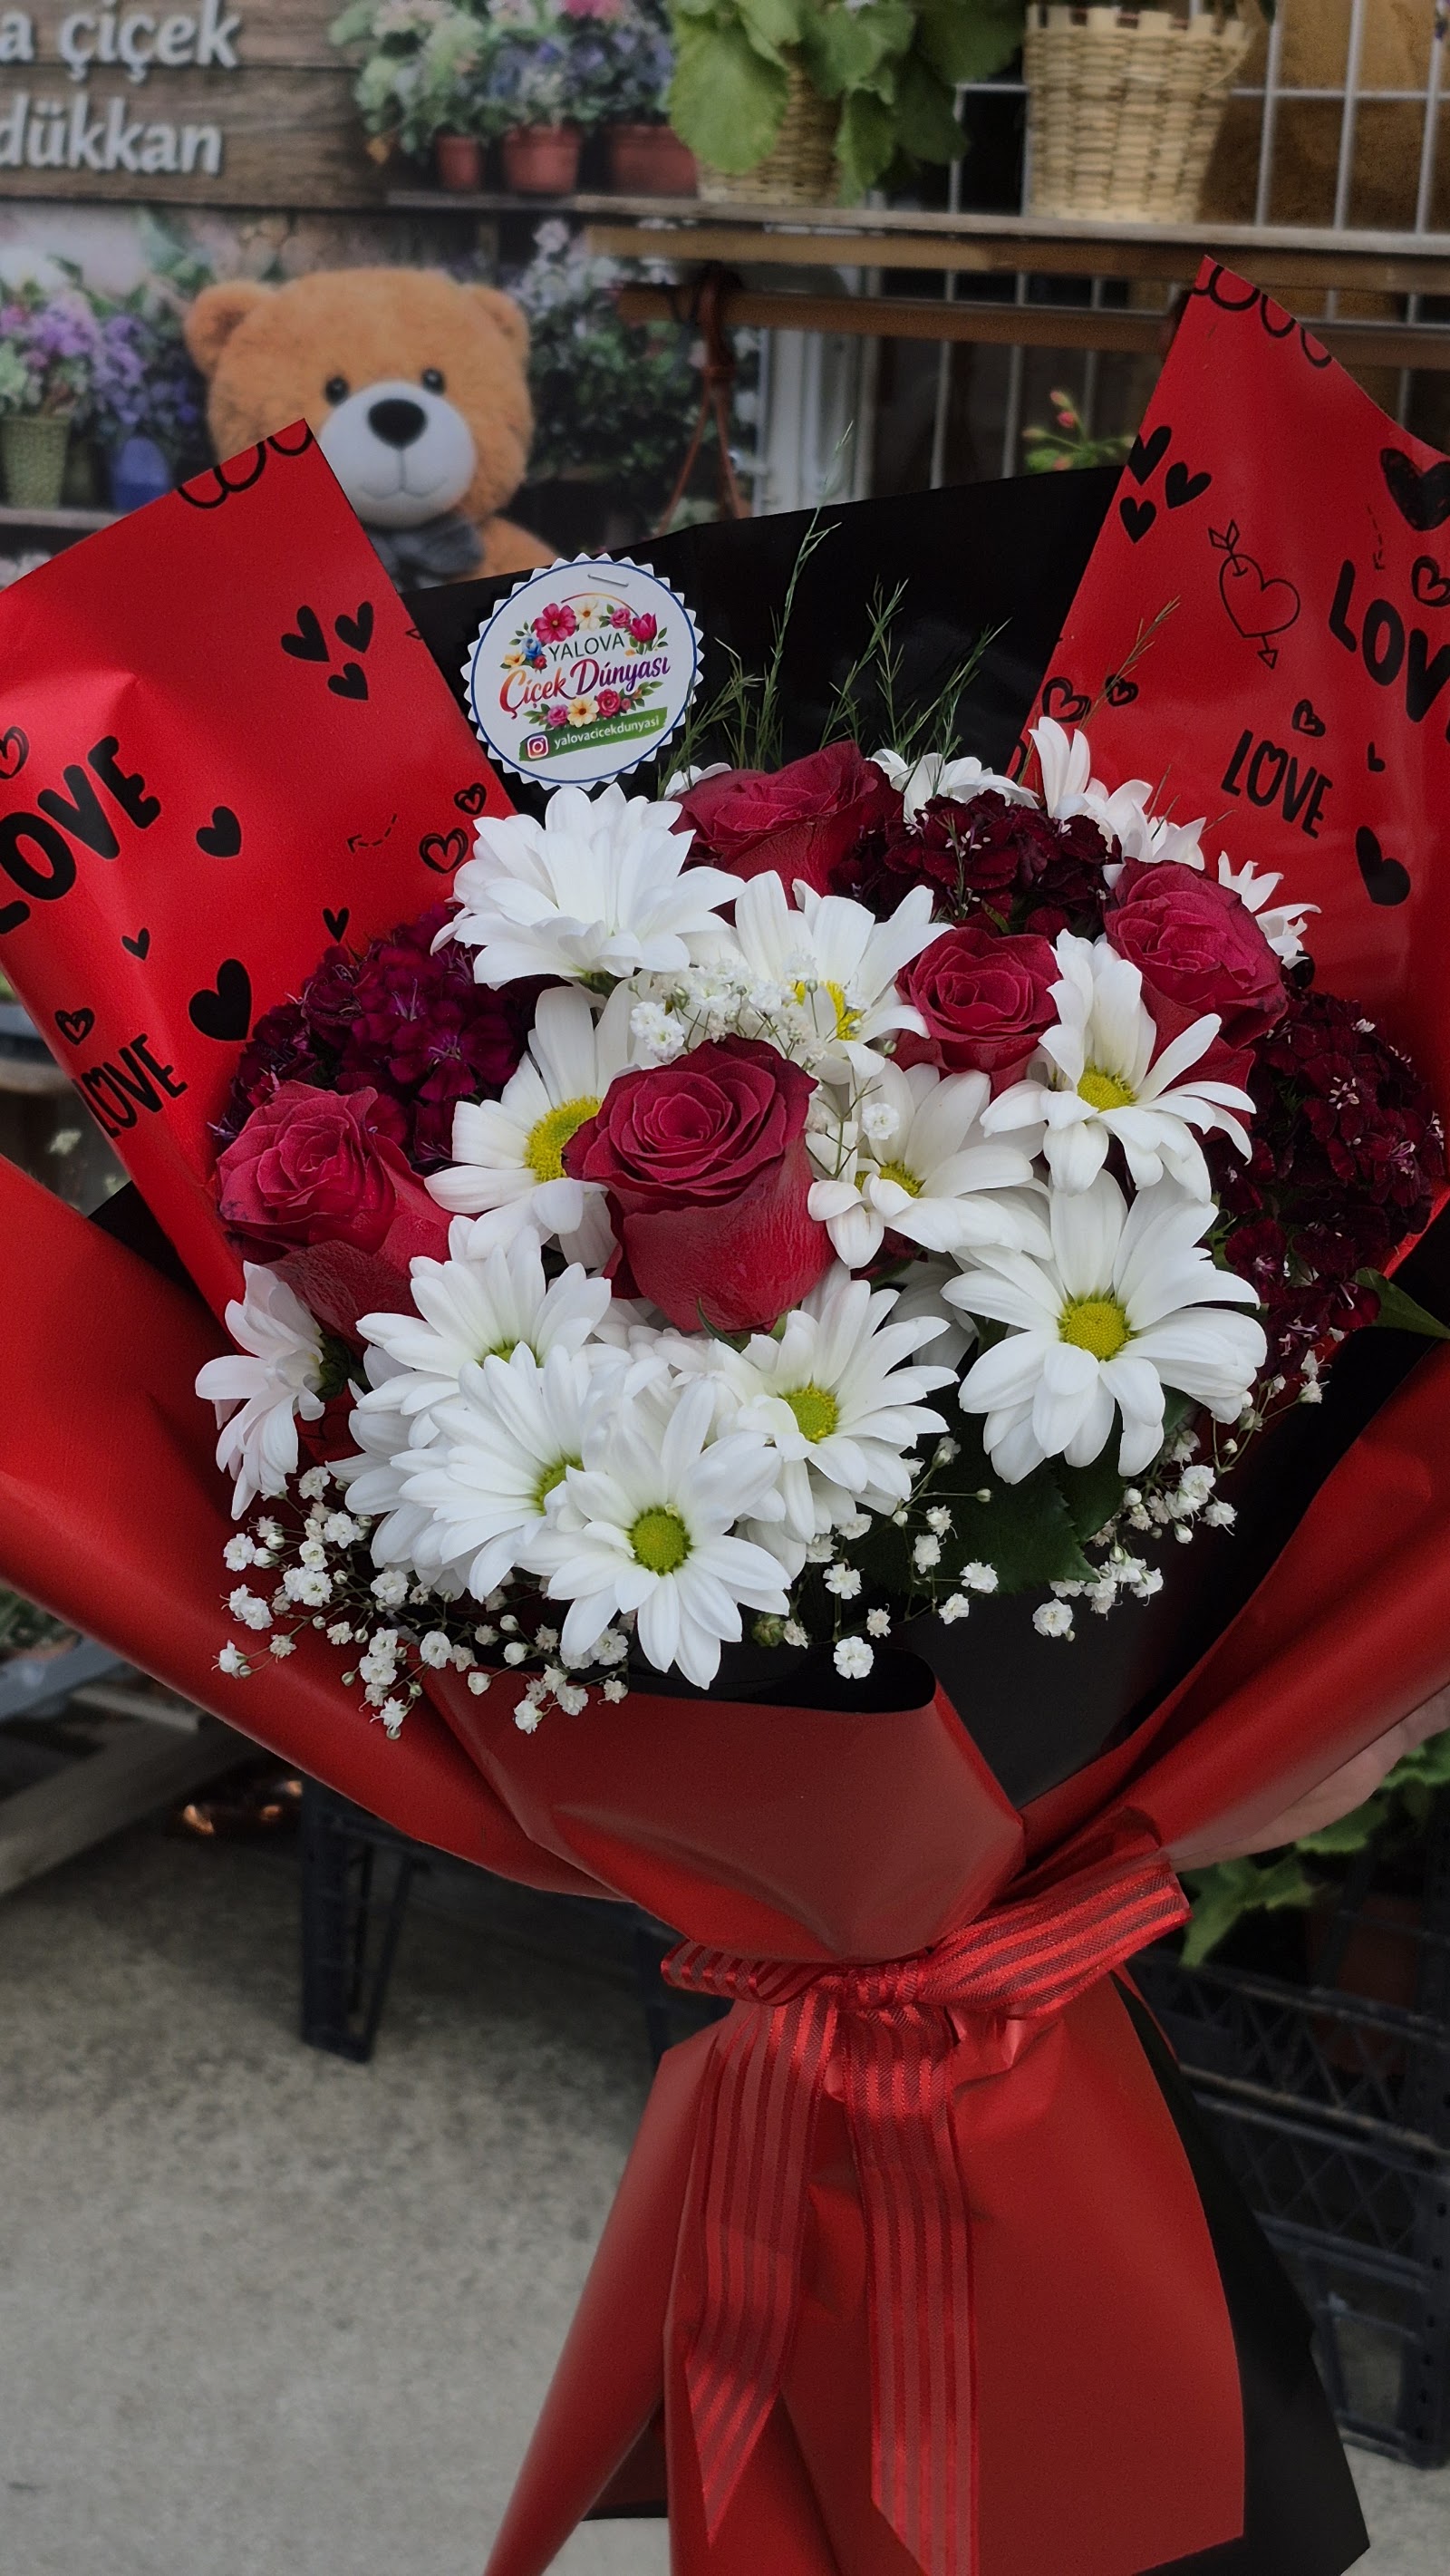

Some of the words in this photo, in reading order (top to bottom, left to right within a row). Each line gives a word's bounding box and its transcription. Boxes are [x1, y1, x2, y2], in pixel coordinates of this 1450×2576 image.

[59, 0, 241, 82] çiçek
[0, 92, 222, 173] dükkan
[548, 632, 625, 663] YALOVA
[1329, 559, 1450, 743] LOV
[499, 667, 576, 720] Çiçek
[554, 715, 660, 750] yalovacicekdunyasi
[1221, 729, 1333, 839] LOVE
